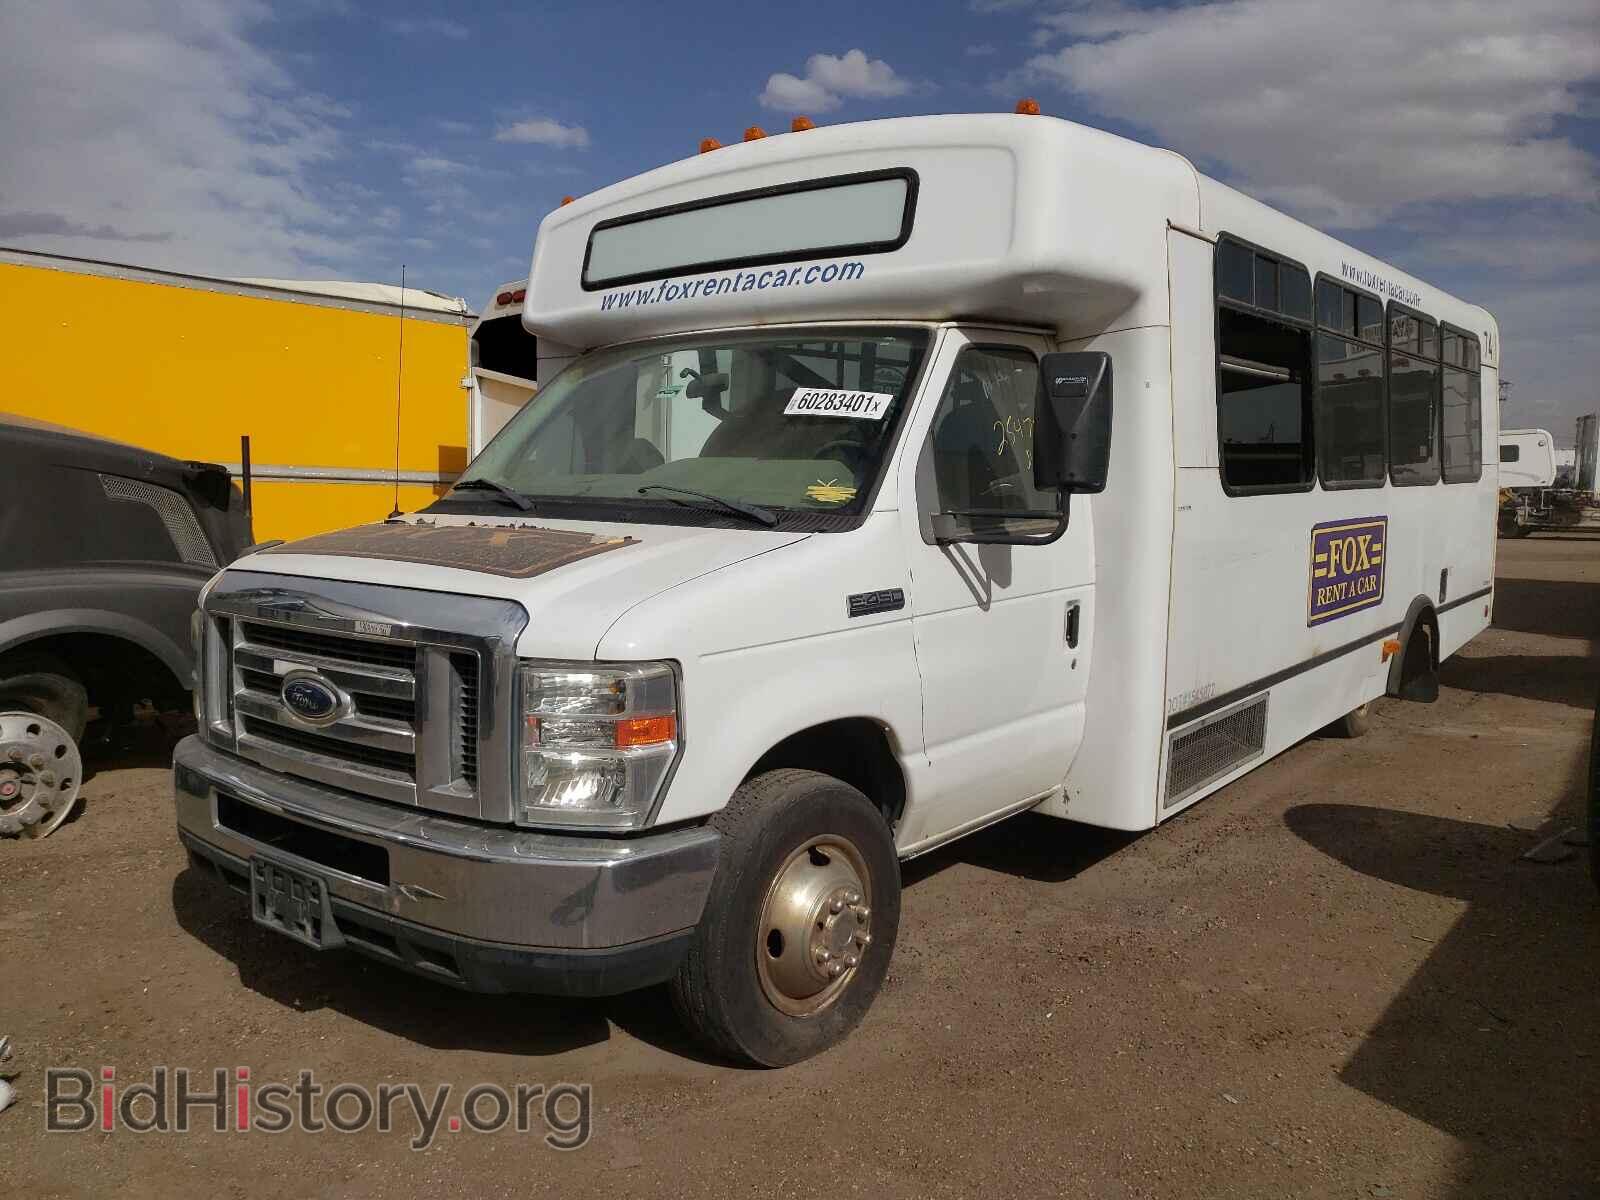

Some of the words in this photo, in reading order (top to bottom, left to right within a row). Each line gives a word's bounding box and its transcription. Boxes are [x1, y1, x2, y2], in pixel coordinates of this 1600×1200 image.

[600, 261, 865, 311] www.foxrentacar.com
[1327, 534, 1372, 579] FOX
[1316, 581, 1348, 607] RENT
[1348, 580, 1356, 598] A
[1357, 574, 1377, 595] CAR
